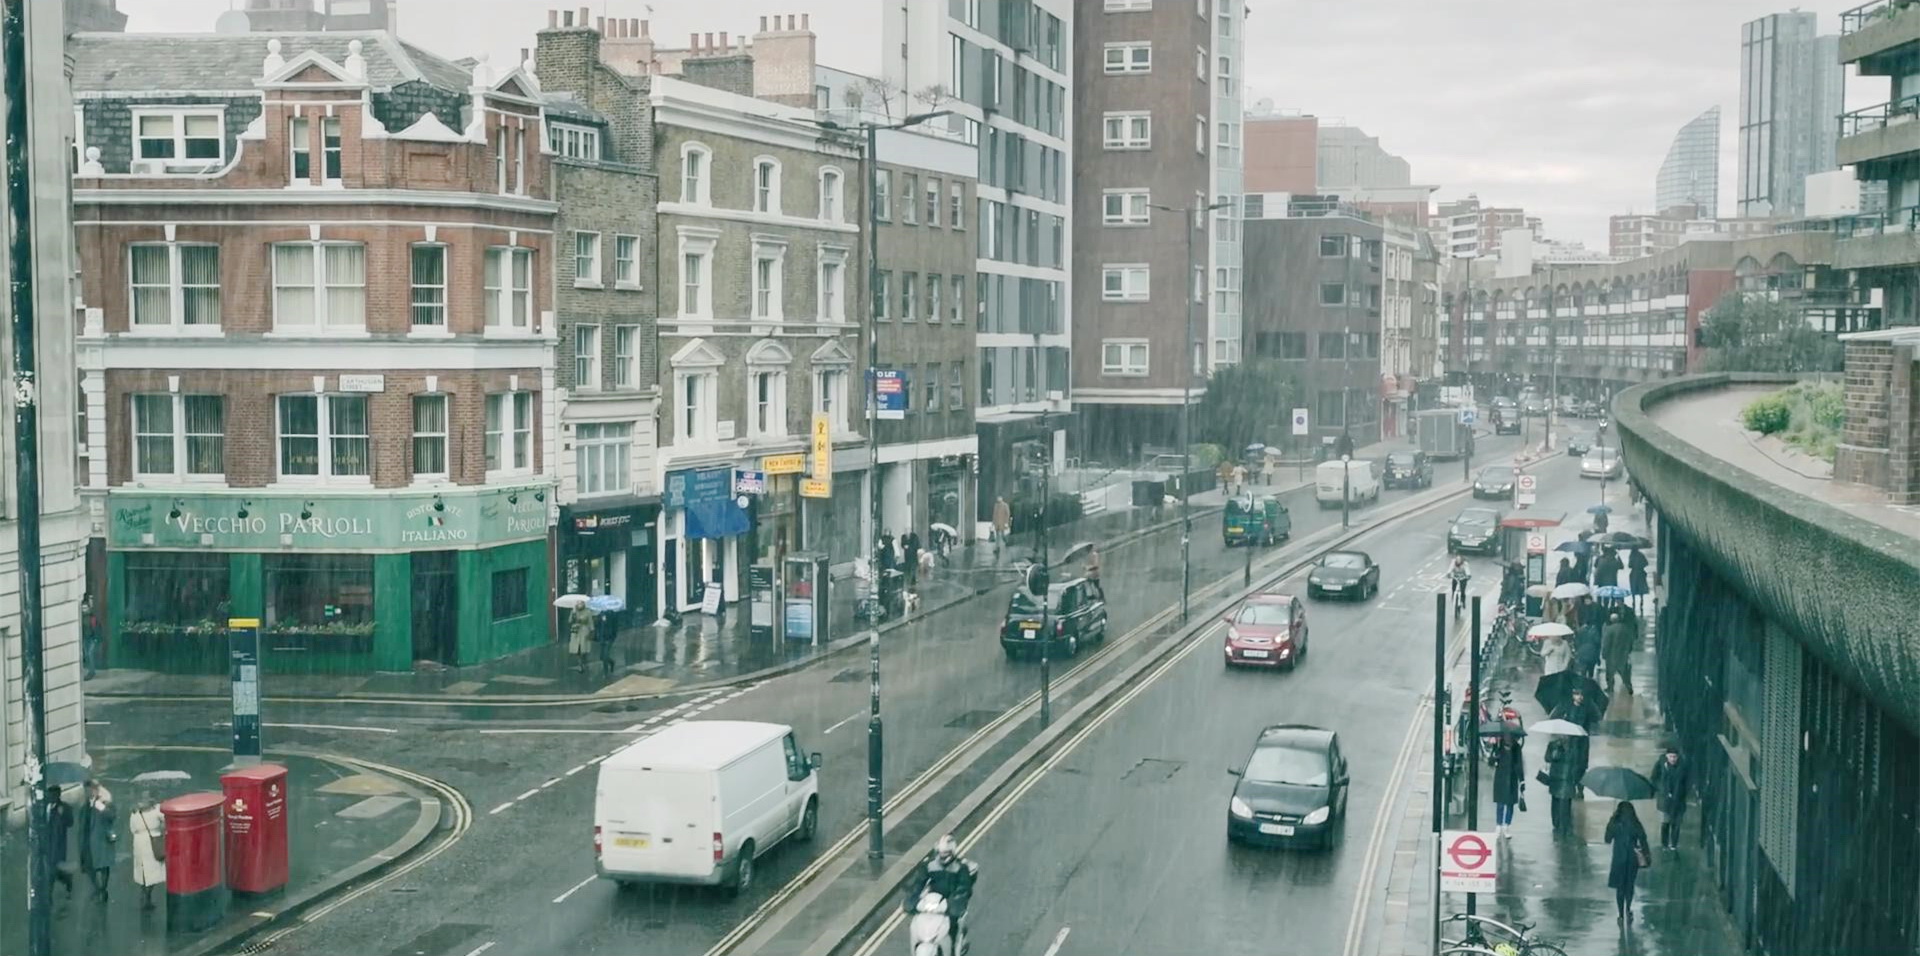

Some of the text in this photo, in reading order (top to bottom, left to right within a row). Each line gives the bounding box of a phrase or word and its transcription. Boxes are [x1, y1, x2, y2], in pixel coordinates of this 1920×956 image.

[165, 511, 266, 534] VECCHIO
[279, 512, 373, 538] PARIOLI
[507, 515, 546, 533] PARIOLI
[401, 529, 468, 542] ITALIANO
